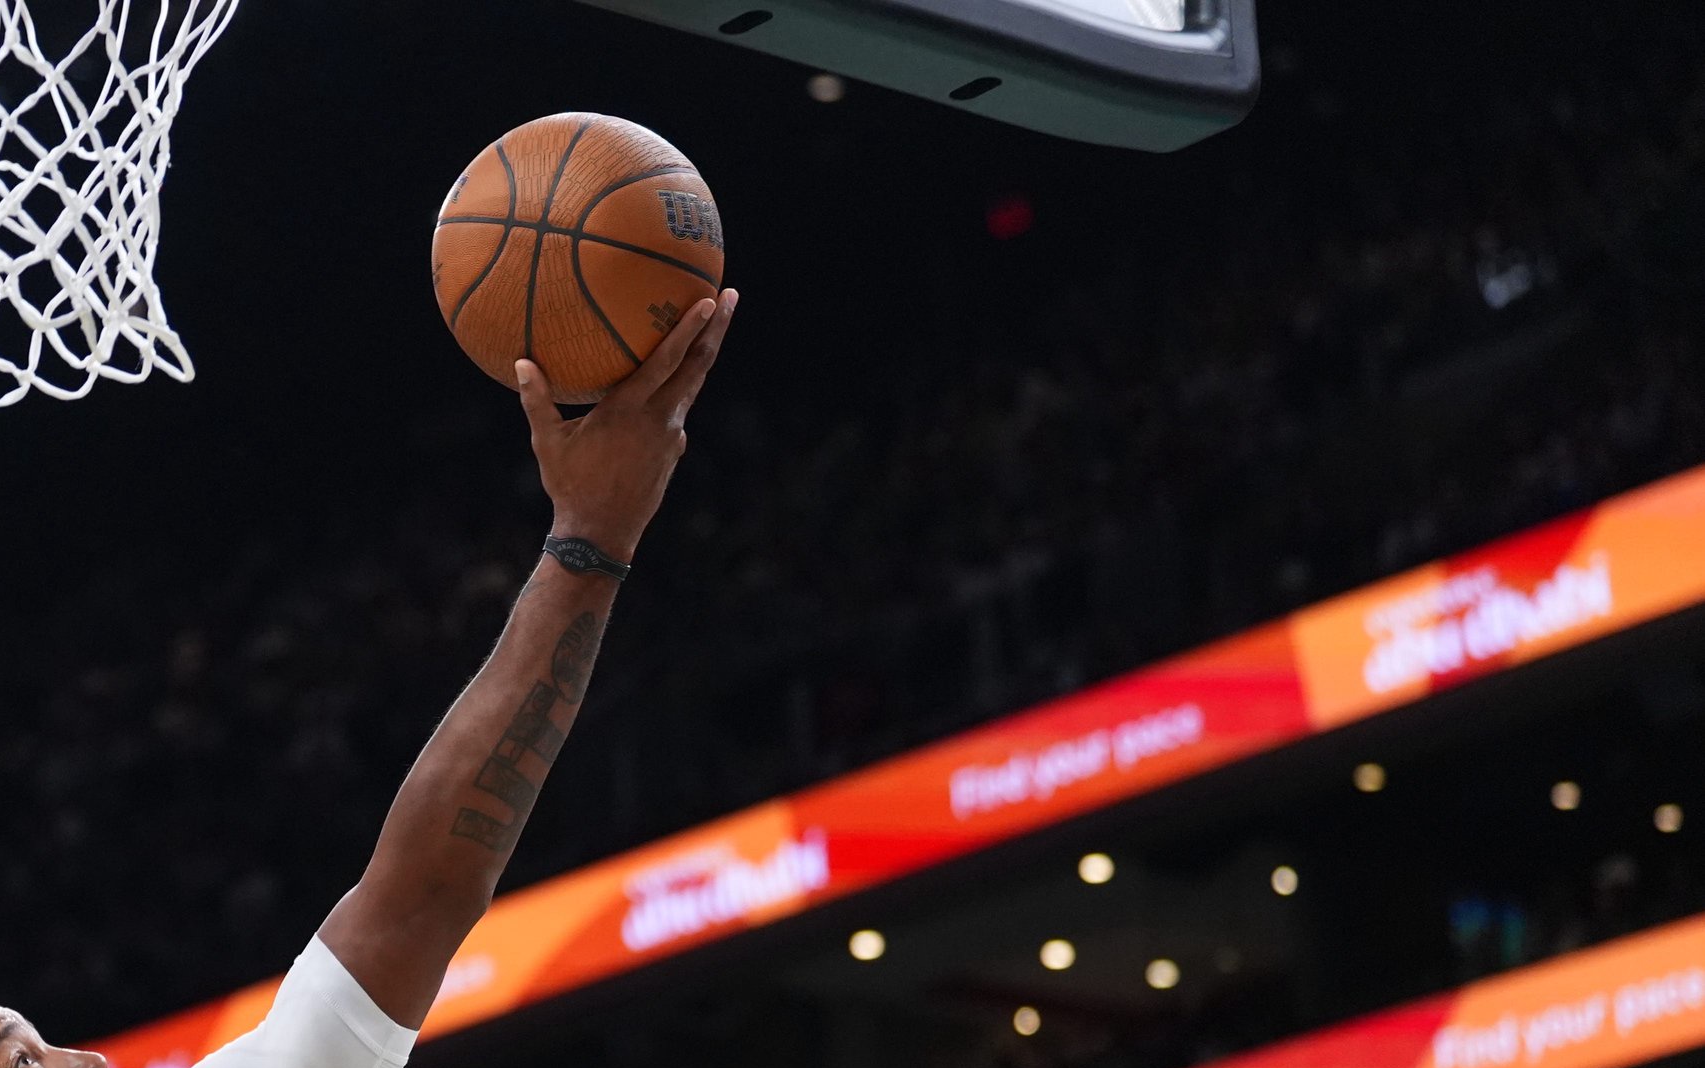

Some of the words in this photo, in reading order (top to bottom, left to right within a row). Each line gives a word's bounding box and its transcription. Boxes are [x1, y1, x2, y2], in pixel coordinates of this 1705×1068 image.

[949, 752, 1034, 821] Find
[1033, 727, 1111, 801] your
[1112, 702, 1205, 777] pace
[1524, 991, 1606, 1066] your
